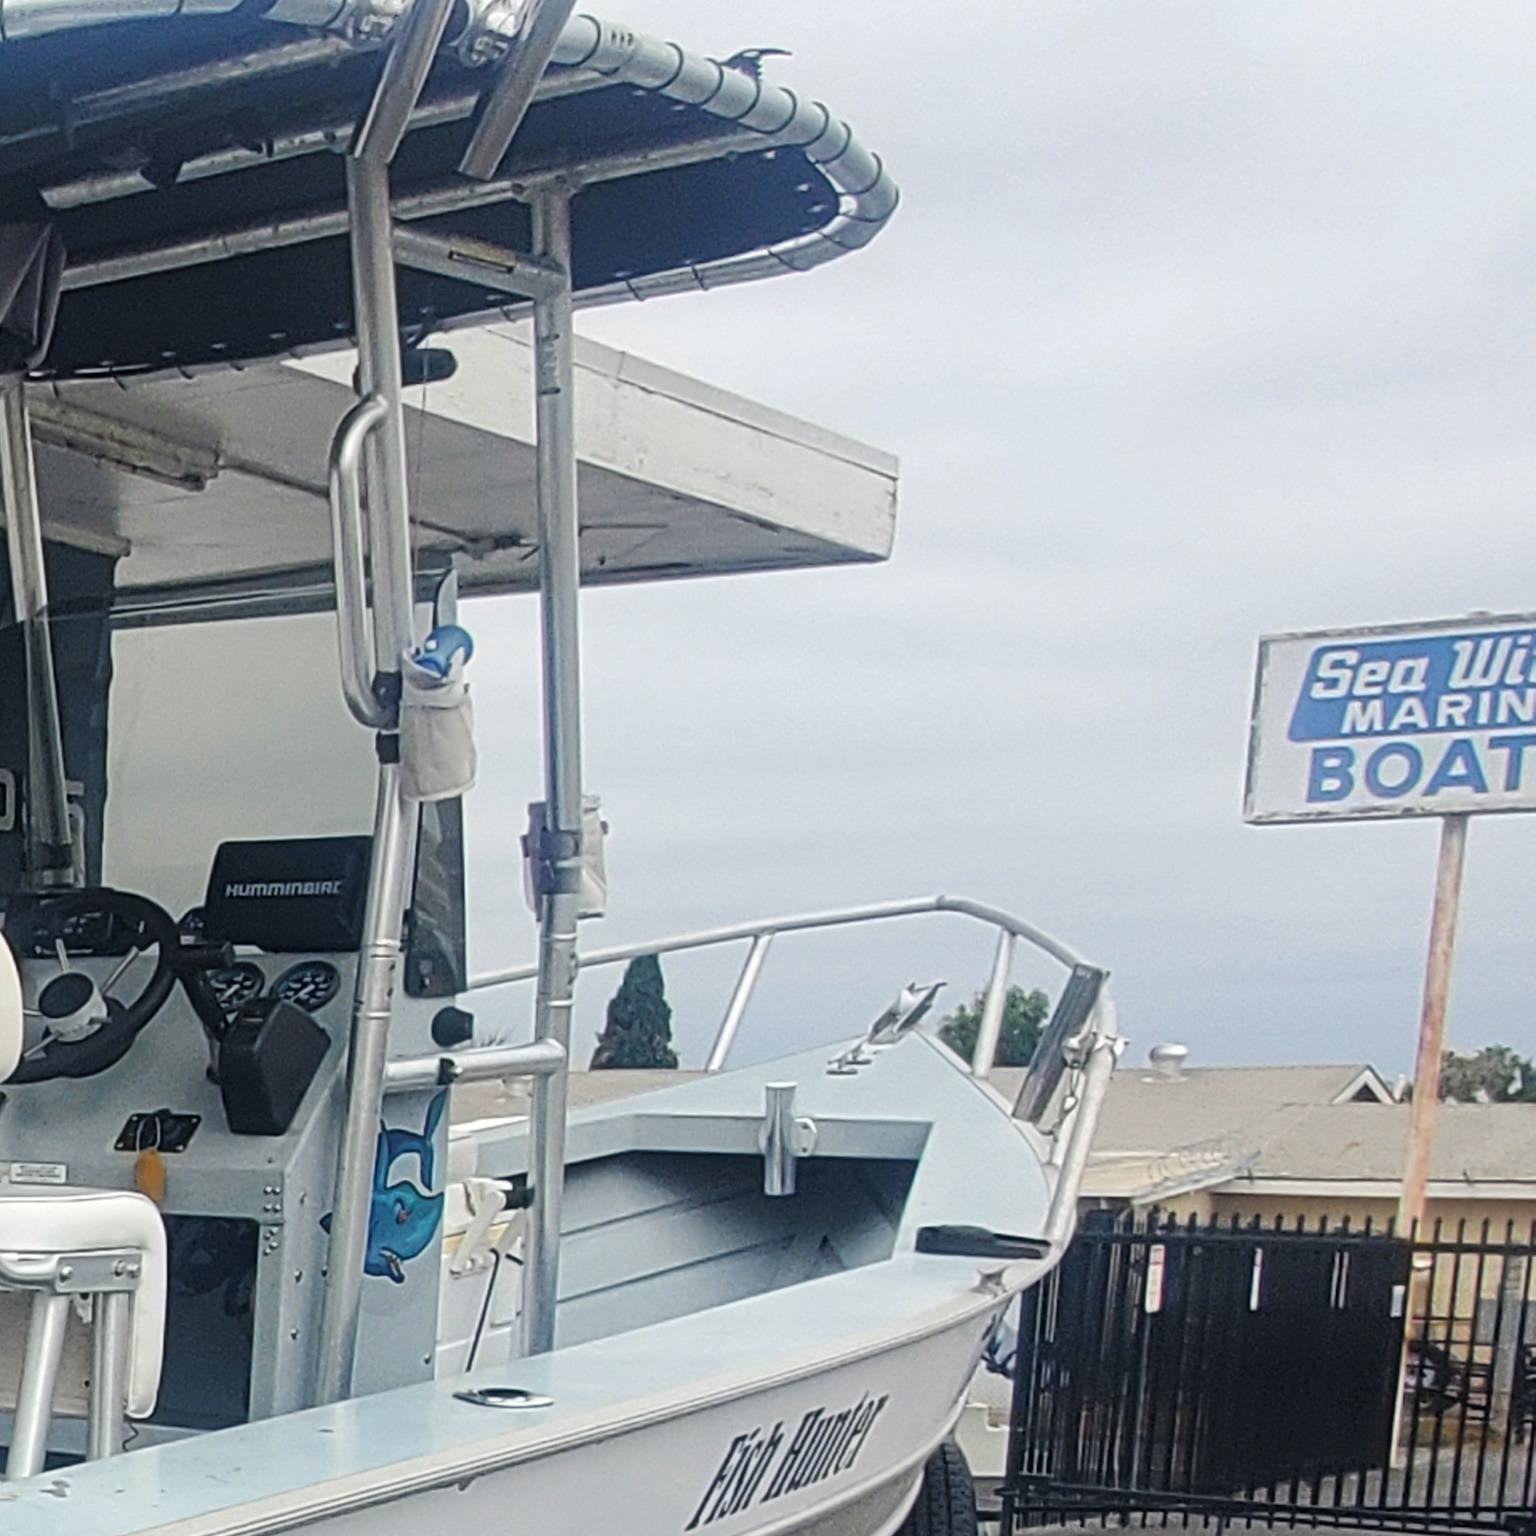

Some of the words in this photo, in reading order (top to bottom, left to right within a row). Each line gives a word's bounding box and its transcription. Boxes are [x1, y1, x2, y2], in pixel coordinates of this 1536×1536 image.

[1310, 650, 1428, 699] Sea
[1340, 688, 1536, 733] MARIN
[1306, 735, 1536, 803] BOAT
[685, 1421, 784, 1531] Fish
[760, 1390, 889, 1503] Hunter
